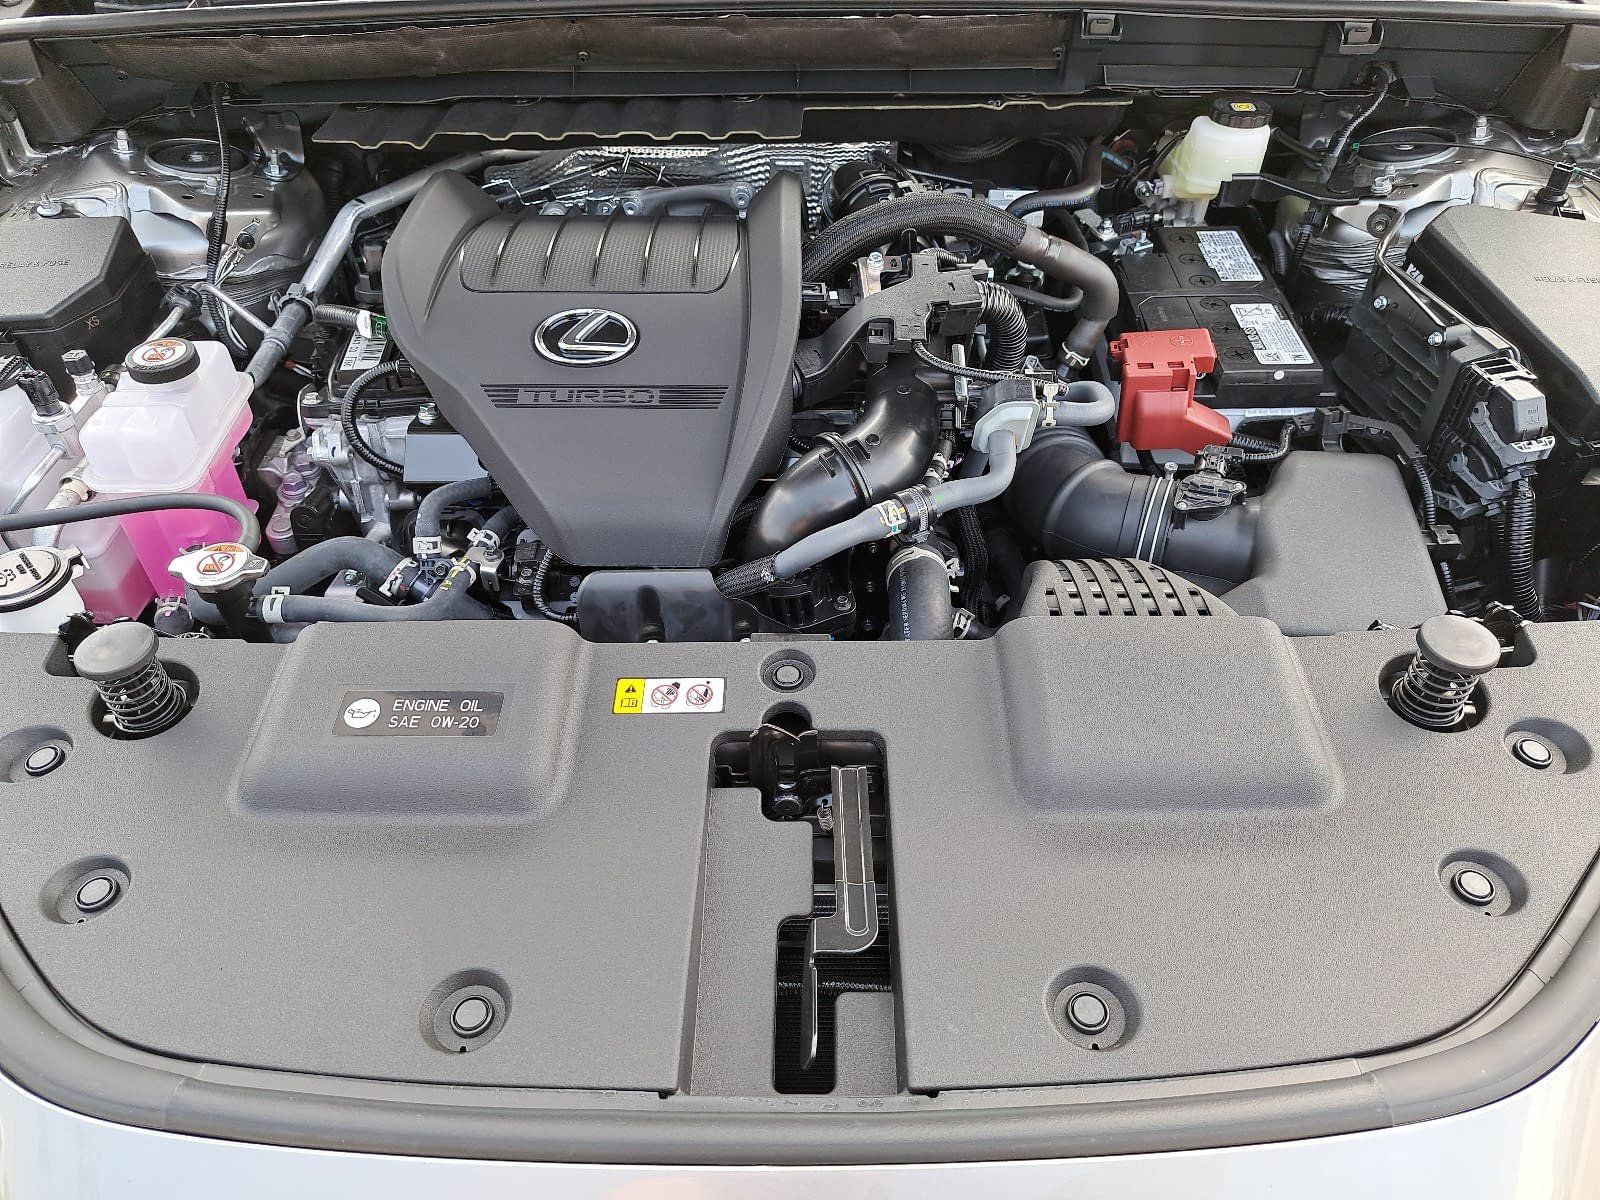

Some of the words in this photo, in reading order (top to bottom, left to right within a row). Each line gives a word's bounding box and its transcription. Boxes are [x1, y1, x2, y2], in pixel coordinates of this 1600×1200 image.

[523, 389, 655, 404] TURBO
[392, 699, 450, 712] ENGINE
[460, 699, 484, 712] OIL
[388, 715, 421, 728] SAE
